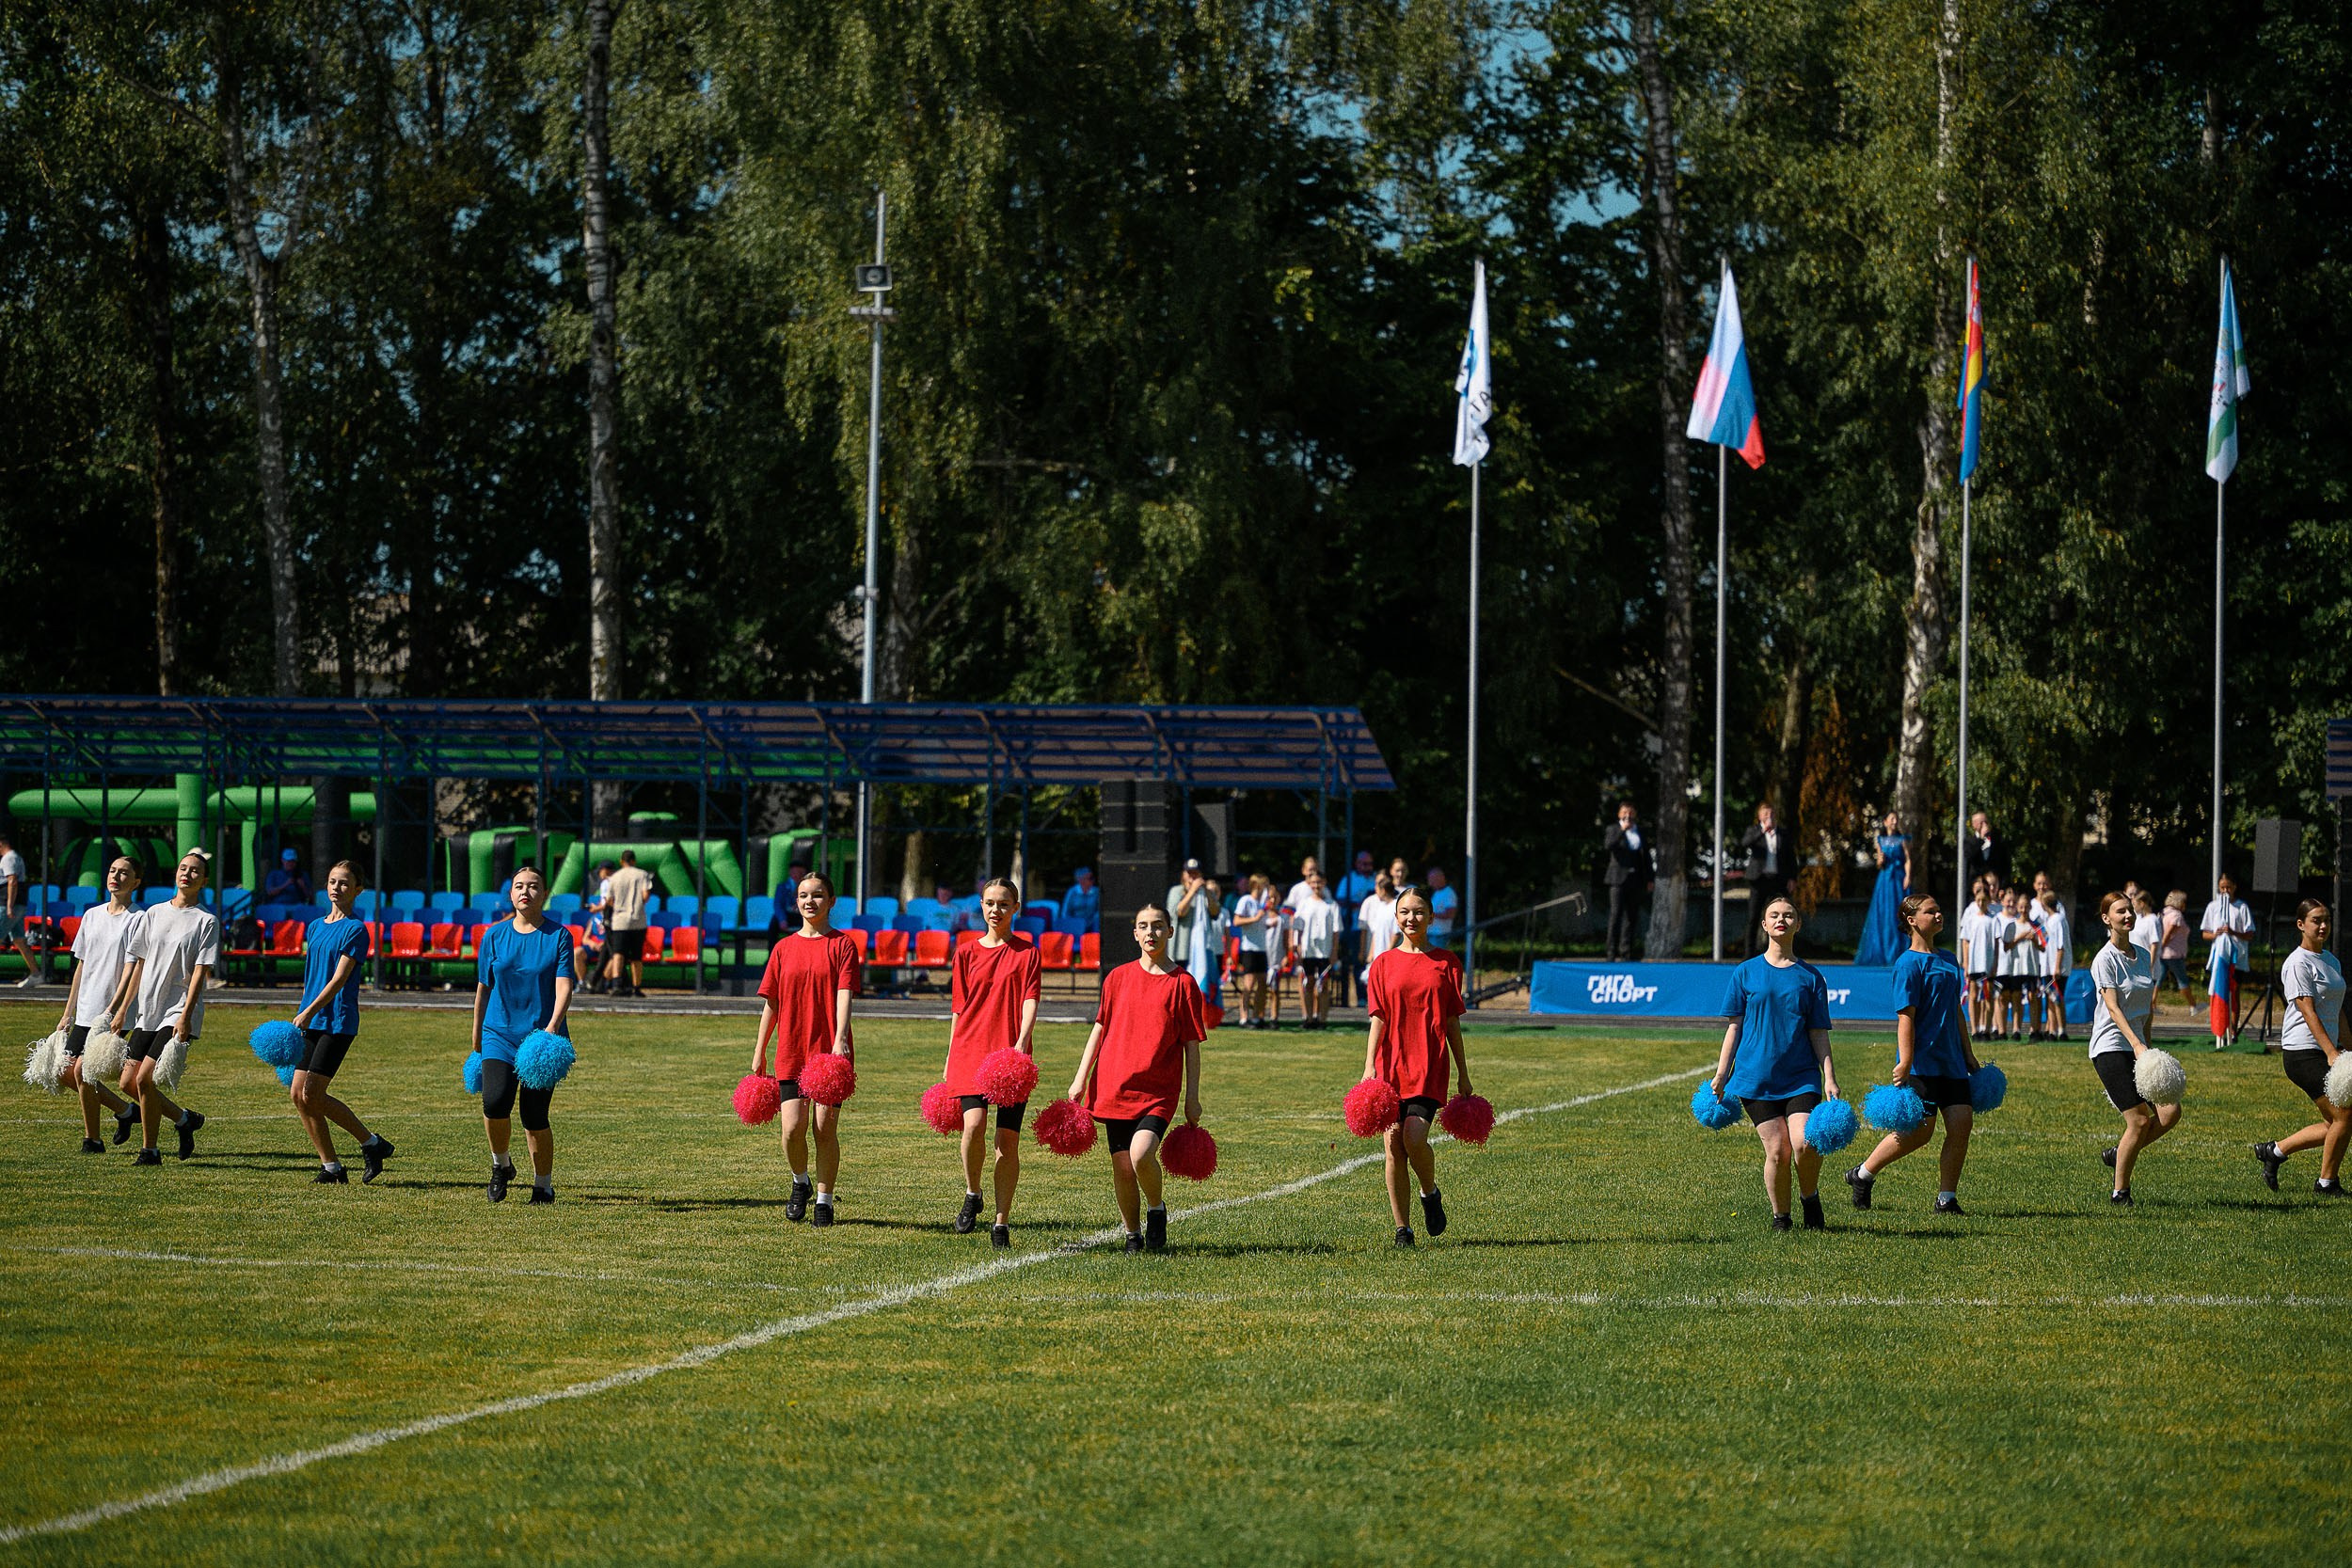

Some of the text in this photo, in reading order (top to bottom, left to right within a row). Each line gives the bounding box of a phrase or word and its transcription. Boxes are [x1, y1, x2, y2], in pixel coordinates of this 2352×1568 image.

[1587, 974, 1634, 992] ГИГА
[1591, 986, 1658, 1004] СПОРТ
[1826, 989, 1851, 1005] РТ
